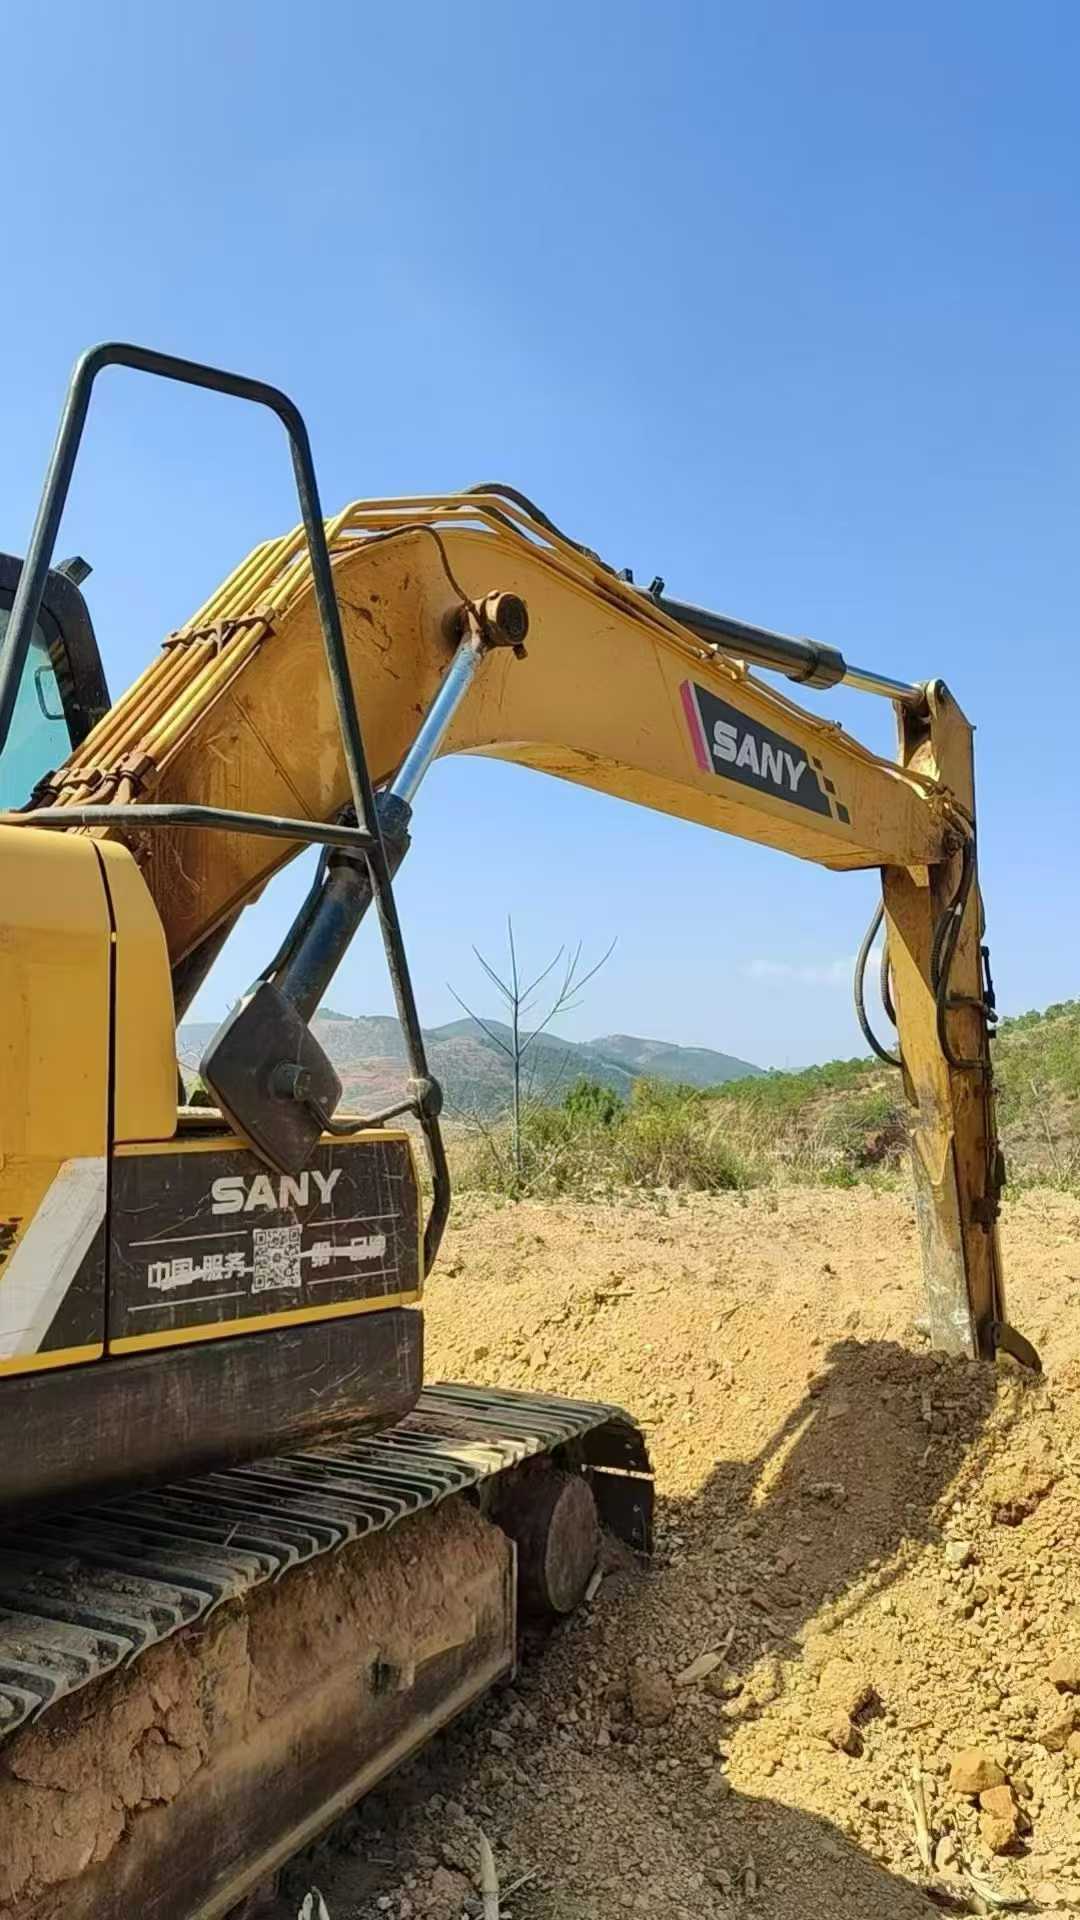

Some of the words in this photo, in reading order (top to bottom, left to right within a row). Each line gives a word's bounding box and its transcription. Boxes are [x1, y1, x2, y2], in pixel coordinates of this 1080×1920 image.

[713, 720, 807, 792] SANY
[211, 1168, 342, 1215] SANY
[311, 1235, 386, 1268] 第品
